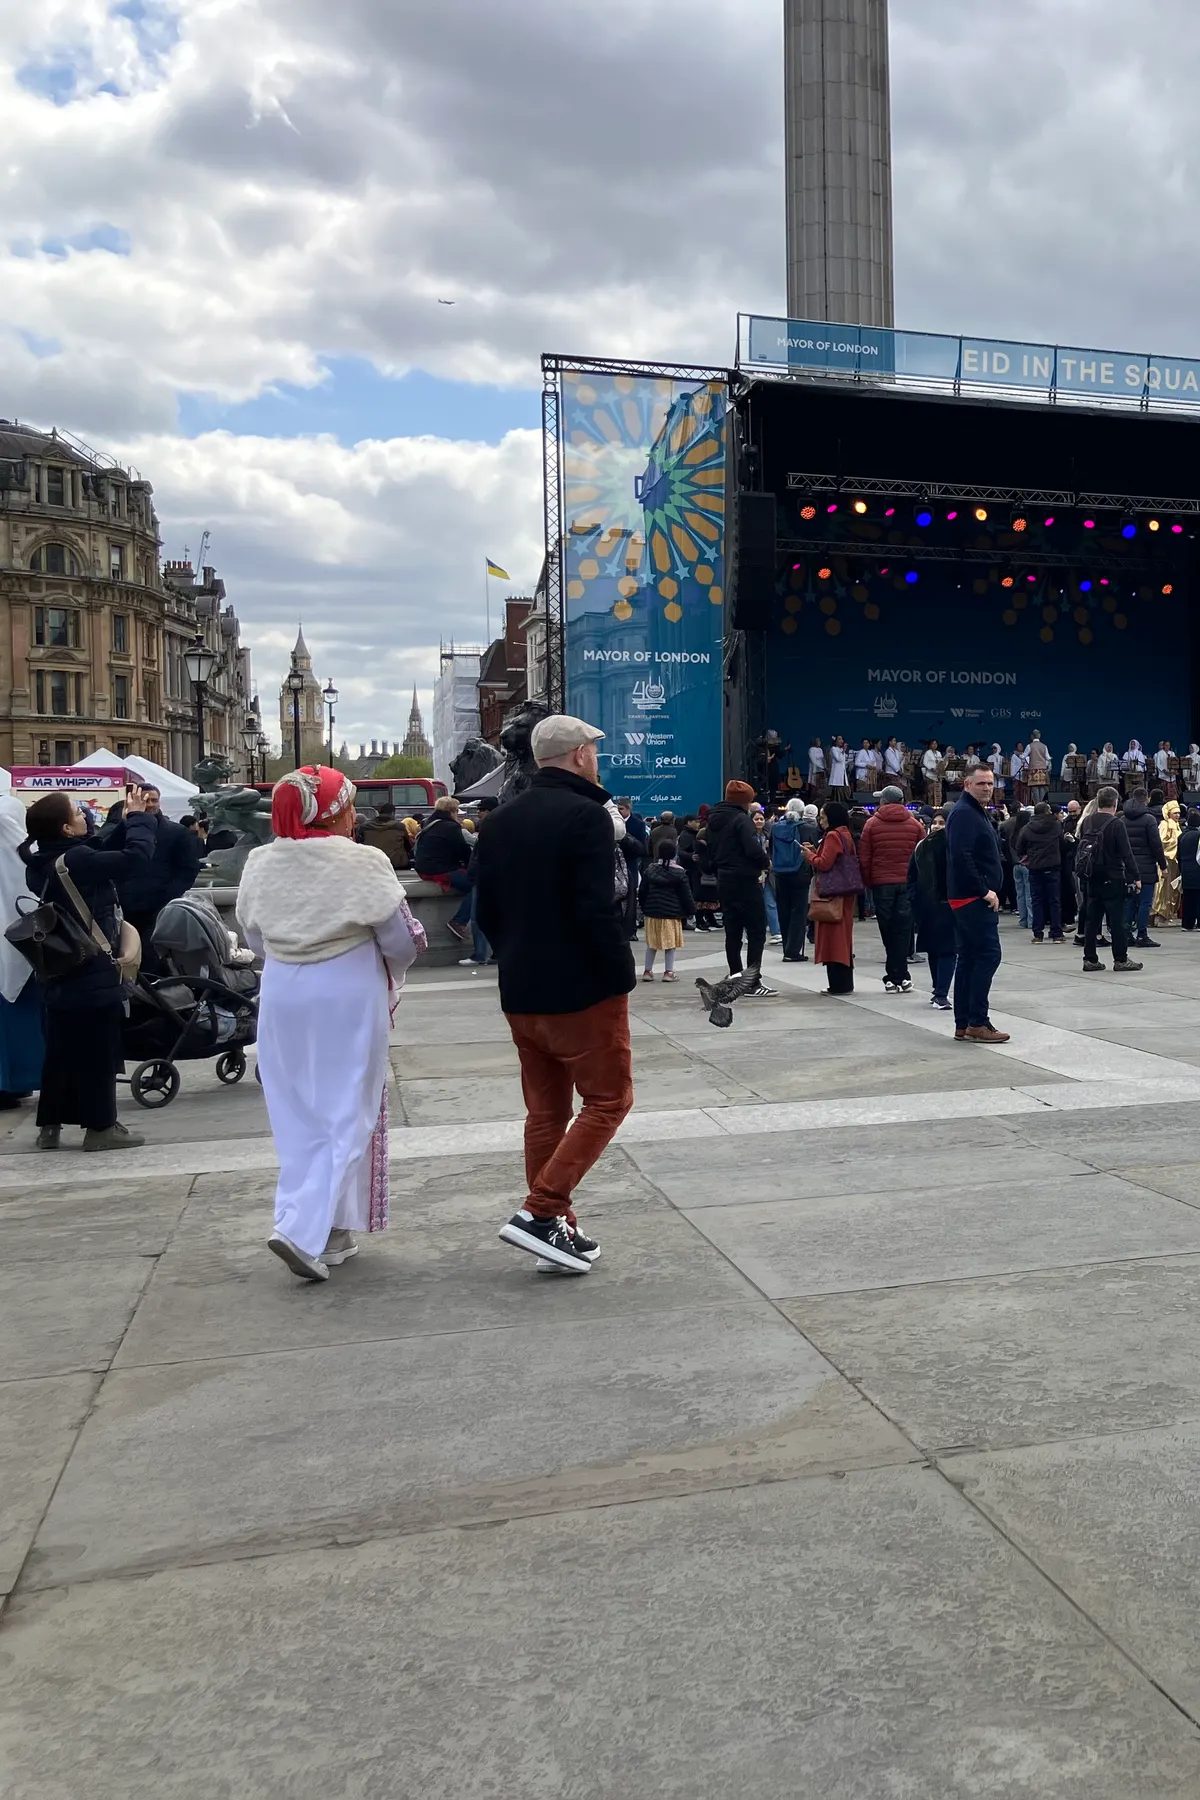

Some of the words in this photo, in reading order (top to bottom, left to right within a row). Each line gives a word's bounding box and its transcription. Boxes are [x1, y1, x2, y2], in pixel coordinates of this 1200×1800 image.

[776, 337, 814, 350] MAYOR
[816, 341, 830, 351] OF
[833, 343, 878, 355] LONDON
[963, 349, 1010, 374] EID
[1022, 355, 1049, 378] IN
[1061, 359, 1114, 384] THE
[583, 650, 630, 662] MAYOR
[634, 651, 652, 662] OF
[655, 652, 710, 664] LONDON
[867, 668, 922, 683] MAYOR
[925, 670, 946, 683] OF
[950, 671, 1017, 685] LONDON
[990, 708, 1012, 718] GBS
[611, 753, 642, 766] GBS
[655, 755, 686, 769] gedu
[32, 778, 52, 786] MR
[55, 778, 102, 786] WHIPPY
